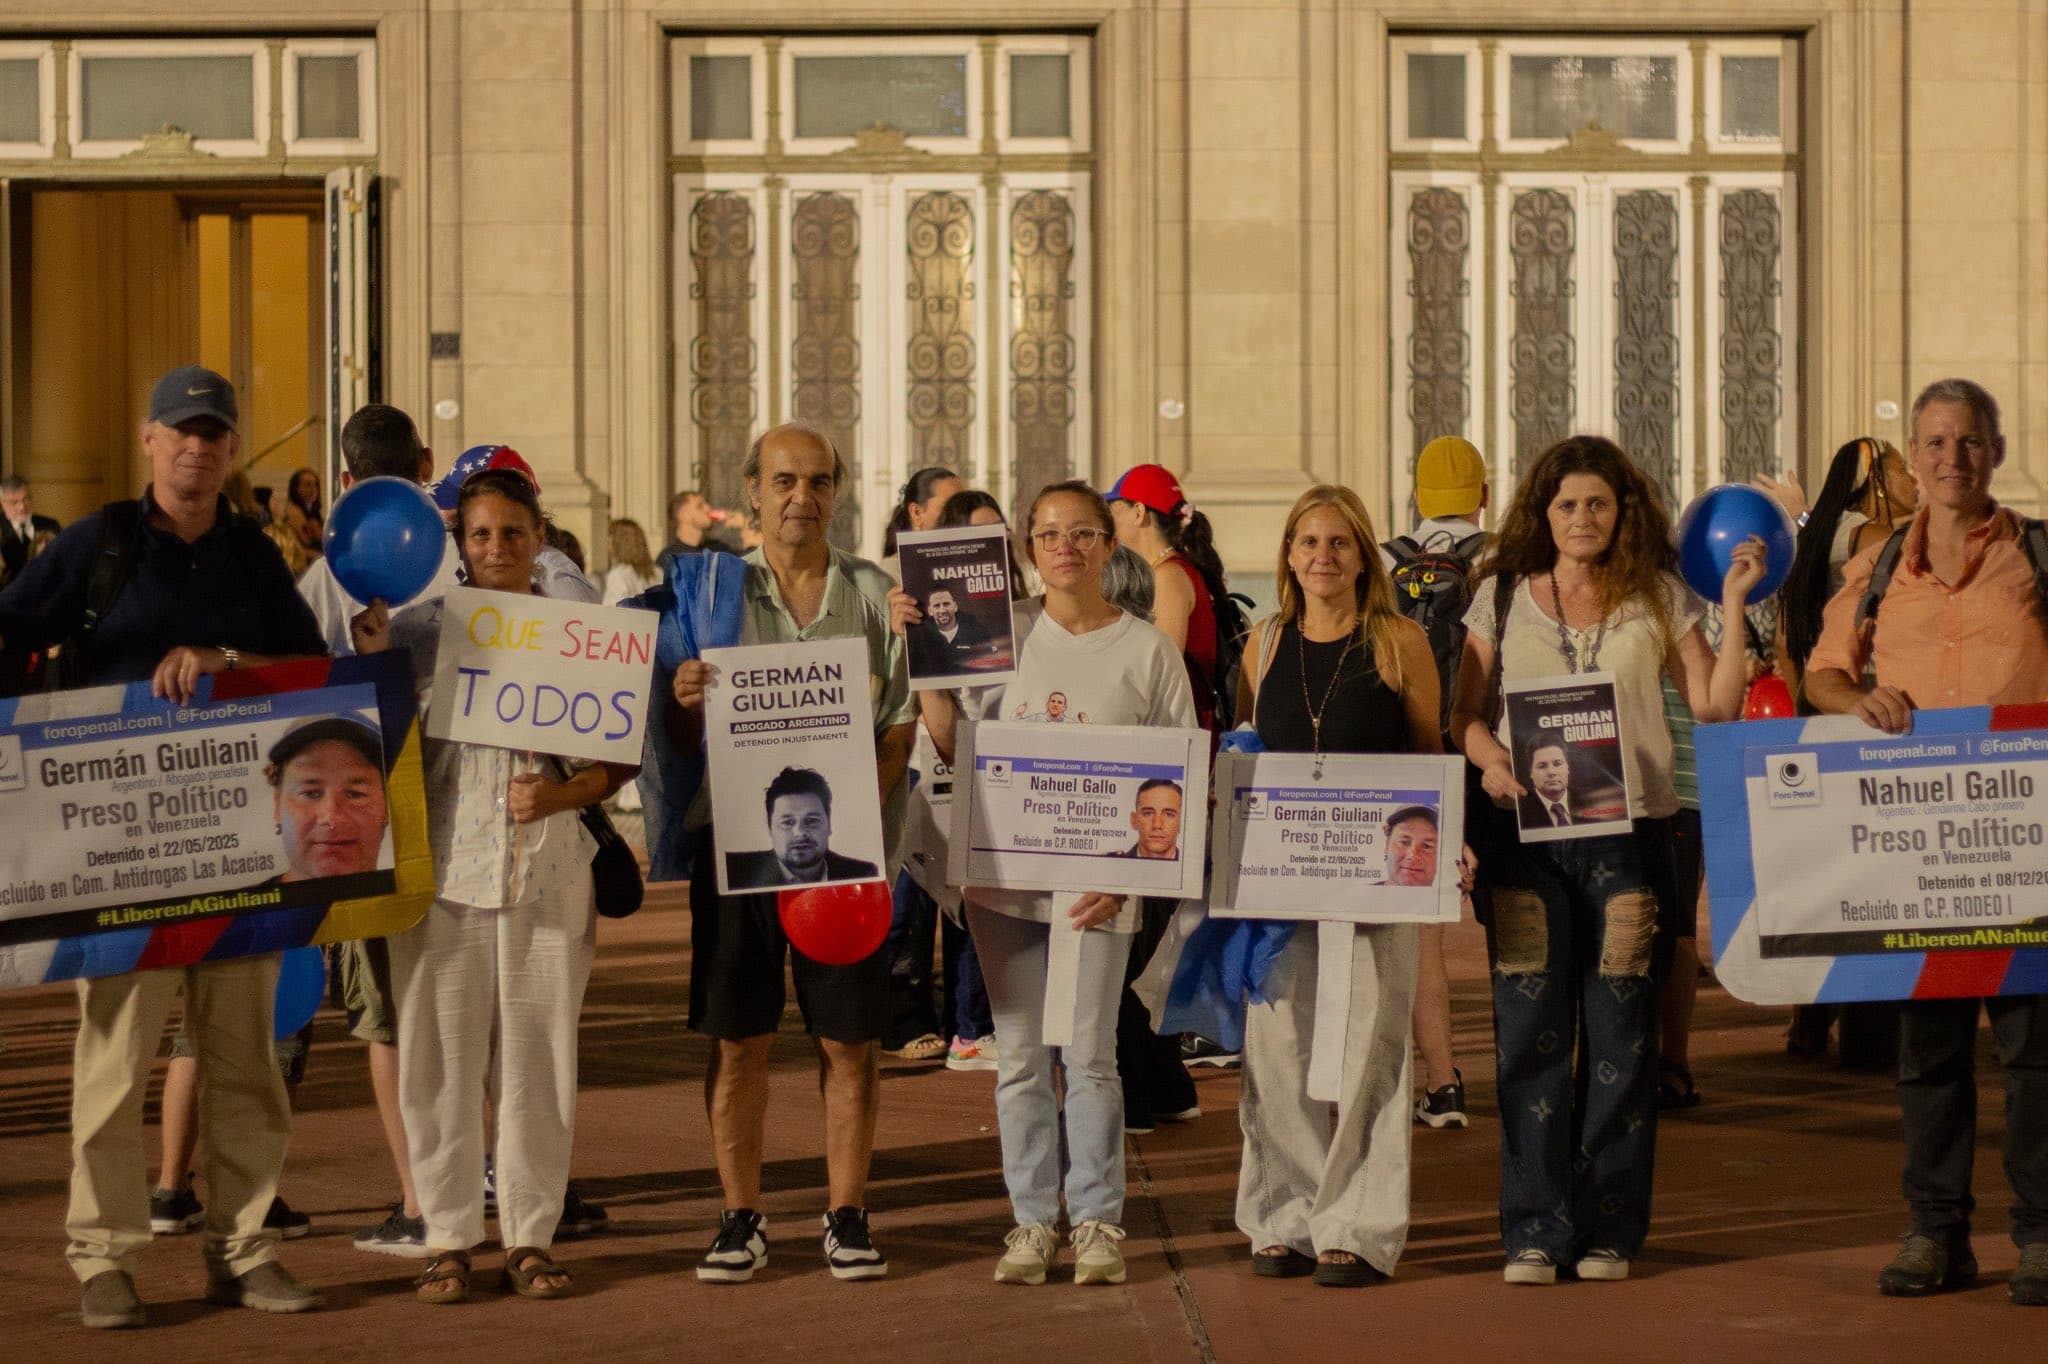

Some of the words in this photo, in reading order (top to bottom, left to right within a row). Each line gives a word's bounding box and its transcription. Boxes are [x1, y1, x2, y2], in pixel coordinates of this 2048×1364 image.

[932, 563, 1003, 580] NAHUEL
[967, 575, 1005, 593] GALLO
[468, 607, 545, 650] QUE
[560, 620, 650, 664] SEAN
[731, 661, 842, 689] GERMÁN
[458, 667, 636, 740] TODOS
[732, 687, 844, 712] GIULIANI
[43, 714, 163, 740] foropenal.com
[176, 700, 272, 724] @ForoPenal
[734, 720, 786, 733] ABOGADO
[788, 716, 847, 728] ARGENTINO
[1538, 710, 1613, 728] GERMAN
[734, 738, 779, 748] DETENIDO
[782, 732, 849, 744] INJUSTAMENTE
[1563, 722, 1616, 742] GIULIANI
[1859, 744, 1957, 762] foropenal.com
[1980, 737, 2048, 755] @ForoPen
[40, 749, 146, 787] Germán
[156, 733, 259, 772] Giuliani
[1033, 761, 1081, 771] foropenal.com
[166, 770, 206, 786] Abogado
[207, 766, 249, 783] penalista
[1030, 776, 1077, 792] Nahuel
[1083, 778, 1116, 794] Gallo
[1280, 790, 1338, 800] foropenal.com
[1344, 791, 1392, 800] @ForoPenal
[1859, 773, 1953, 806] Nahuel
[1965, 769, 2034, 800] Gallo
[61, 801, 138, 830] Preso
[147, 783, 248, 819] Político
[1023, 799, 1061, 815] Preso
[1067, 800, 1118, 817] Político
[1274, 806, 1326, 821] Germán
[1332, 808, 1382, 822] Giuliani
[126, 825, 142, 837] en
[147, 813, 221, 835] Venezuela
[1055, 837, 1067, 849] C.P.
[1069, 838, 1093, 850] RODEO
[1281, 829, 1318, 844] Preso
[1324, 830, 1373, 845] Político
[1851, 824, 1926, 854] Preso
[1938, 817, 2043, 850] Político
[87, 847, 144, 867] Detenido
[148, 845, 159, 859] el
[164, 833, 239, 857] 22/05/2025
[1290, 854, 1318, 864] Detenido
[1328, 855, 1366, 865] 22/05/2025
[1923, 854, 1938, 866] en
[1944, 848, 2011, 865] Venezuela
[51, 881, 67, 899] en
[73, 873, 108, 896] Com.
[113, 864, 187, 888] Antidrogas
[193, 859, 216, 879] Las
[222, 851, 274, 875] Acacias
[1270, 866, 1279, 876] en
[1340, 866, 1352, 878] Las
[1918, 874, 1975, 891] Detenido
[1980, 873, 1992, 887] el
[1996, 871, 2048, 887] 08/12/20
[97, 889, 281, 926] #LiberenAGiuliani
[1841, 899, 1898, 922] Recluido
[1904, 903, 1919, 920] en
[1924, 897, 1949, 919] C.P.
[1954, 894, 2001, 918] RODEO
[1883, 928, 2048, 949] #LiberenANahue
